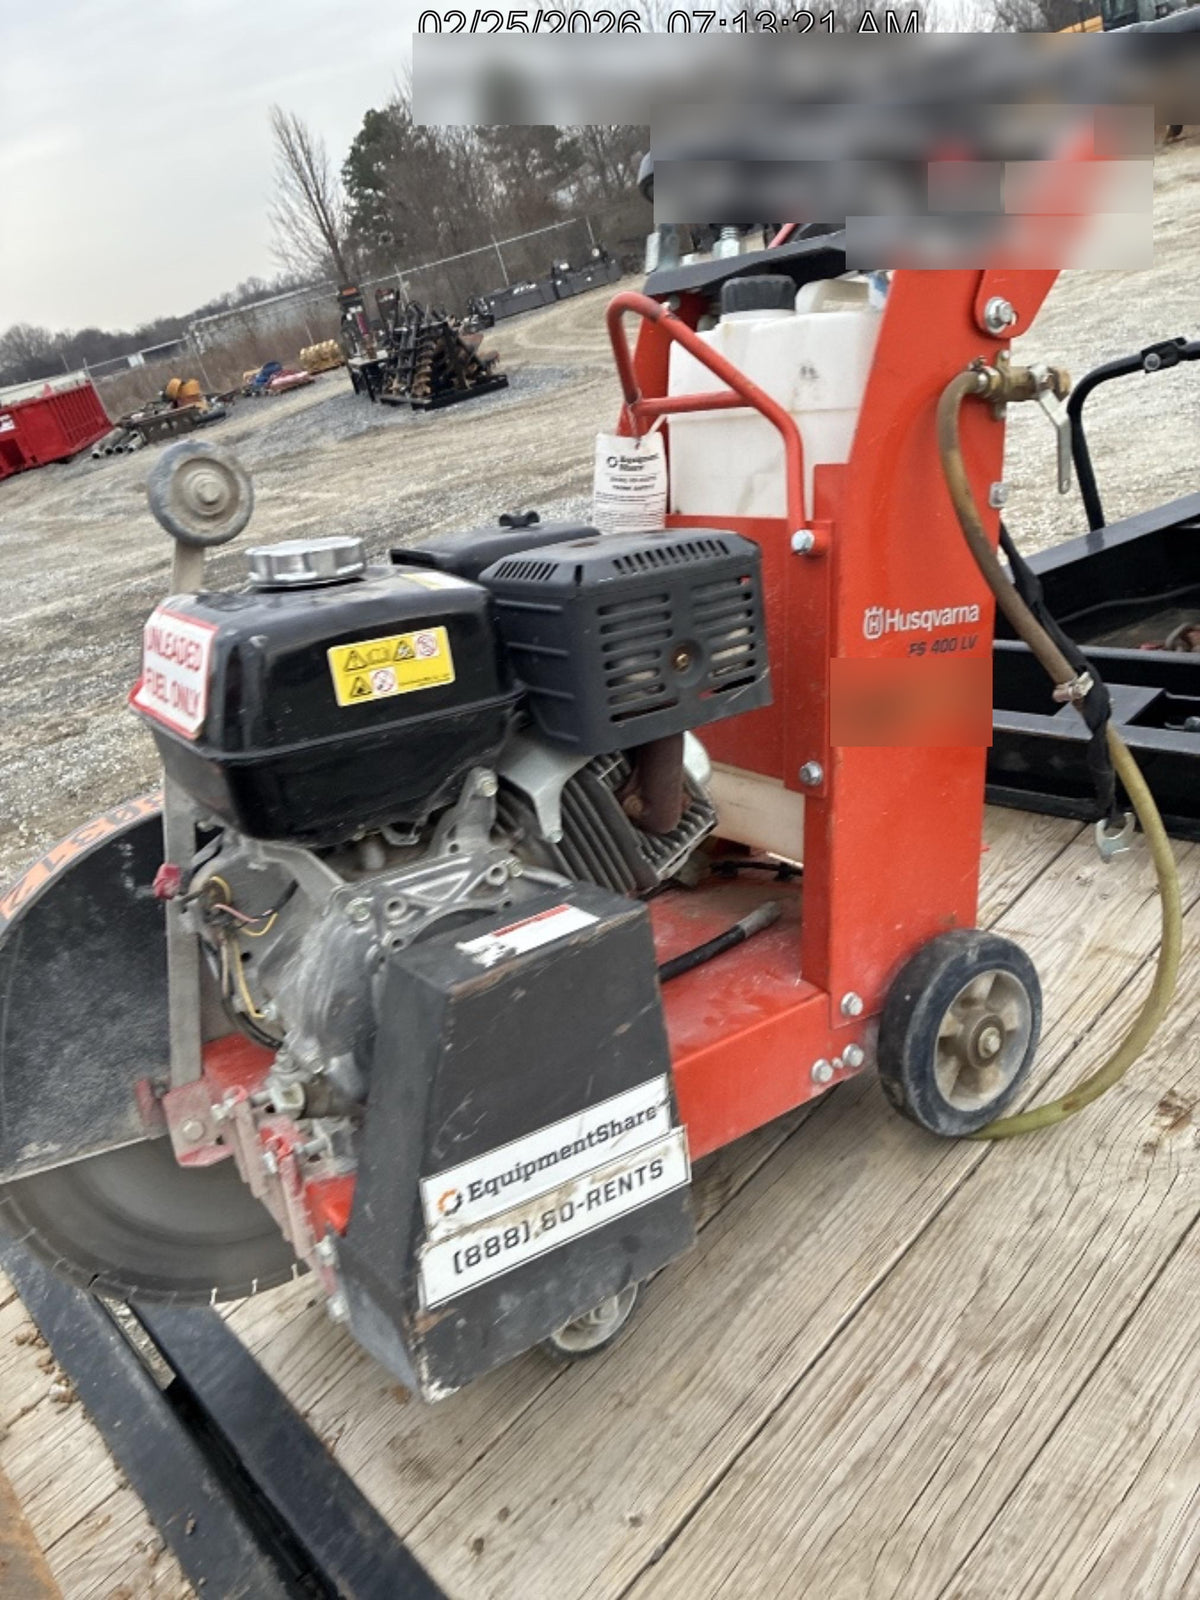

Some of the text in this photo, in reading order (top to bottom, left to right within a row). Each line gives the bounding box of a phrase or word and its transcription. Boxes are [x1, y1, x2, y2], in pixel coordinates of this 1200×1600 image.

[885, 604, 980, 634] Husqvarna
[143, 625, 203, 672] UNLEADED
[930, 637, 957, 654] 400
[960, 635, 978, 651] LV
[144, 667, 201, 719] FUEL ONLY
[467, 1104, 658, 1202] EquipmentShare
[453, 1221, 531, 1275] (888)
